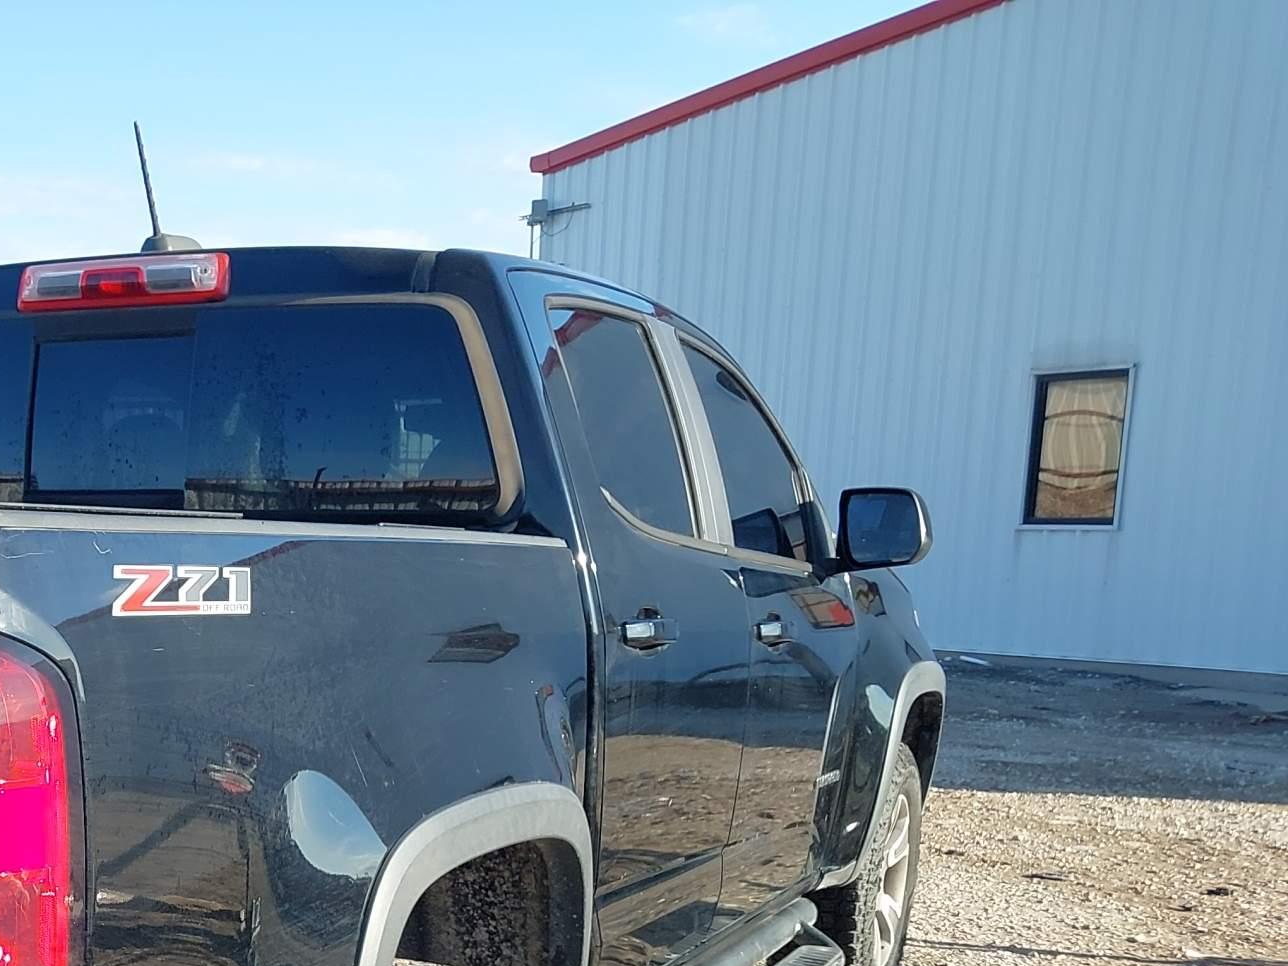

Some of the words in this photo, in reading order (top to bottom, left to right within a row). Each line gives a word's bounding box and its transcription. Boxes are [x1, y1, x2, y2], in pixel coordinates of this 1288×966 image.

[112, 564, 252, 617] Z71
[202, 603, 220, 613] OFF
[223, 602, 249, 612] ROAD
